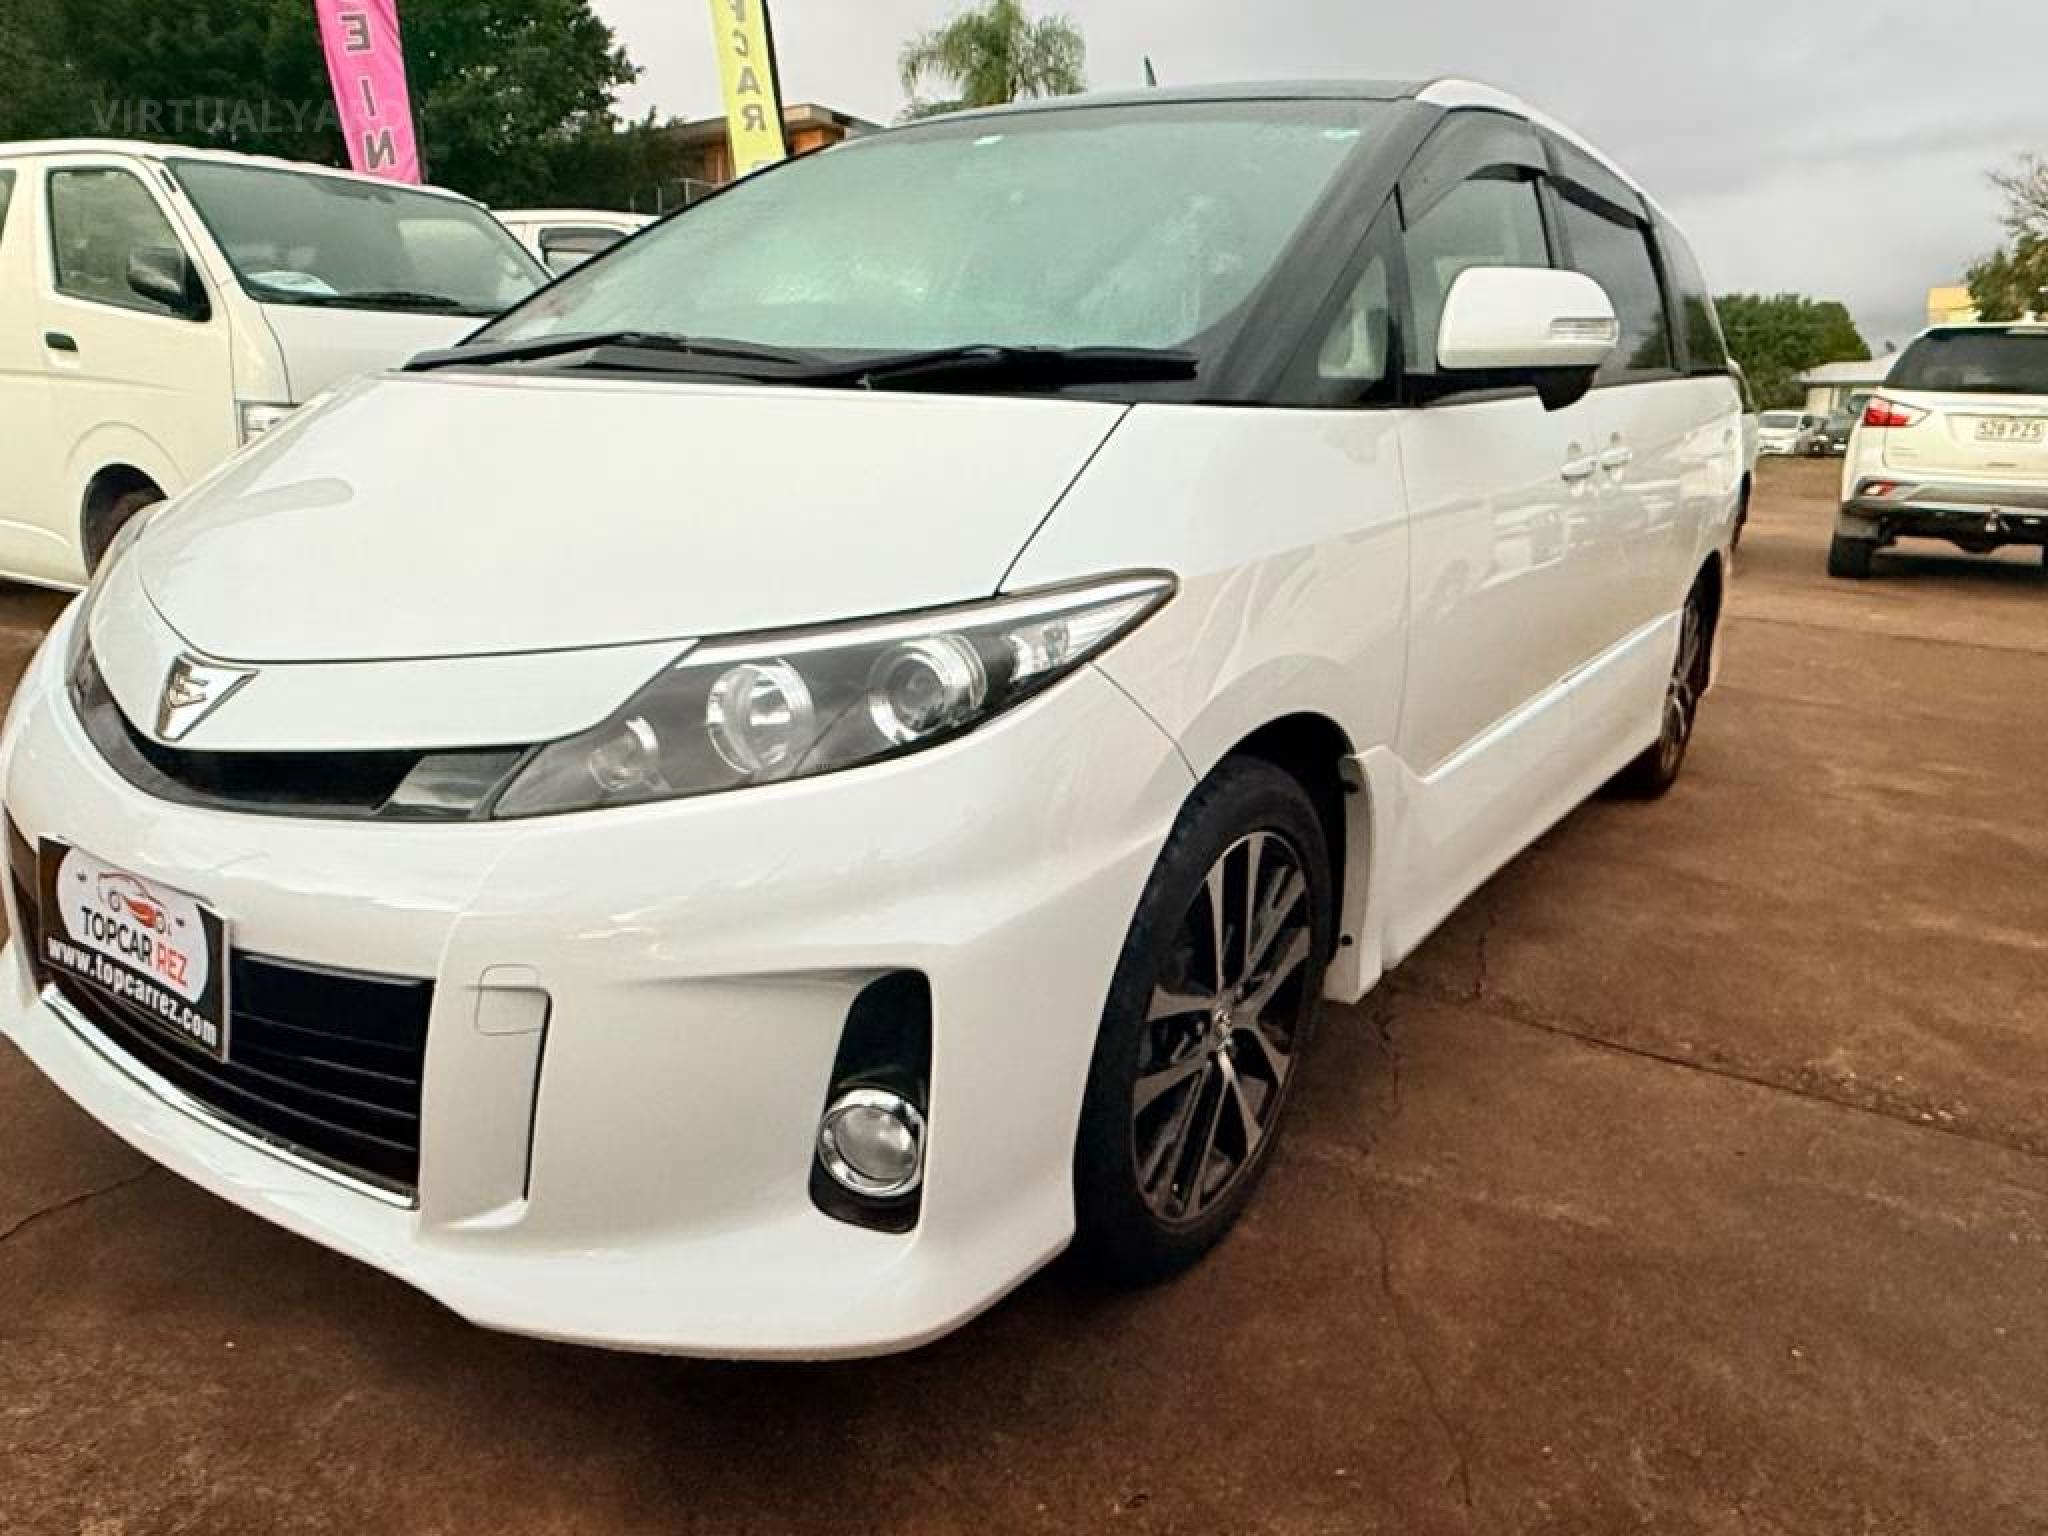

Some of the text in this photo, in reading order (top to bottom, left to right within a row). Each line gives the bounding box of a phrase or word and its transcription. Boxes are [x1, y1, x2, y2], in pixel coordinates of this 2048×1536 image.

[47, 936, 217, 1047] www.topcarrez.com
[81, 905, 187, 987] TOPCAR REZ
